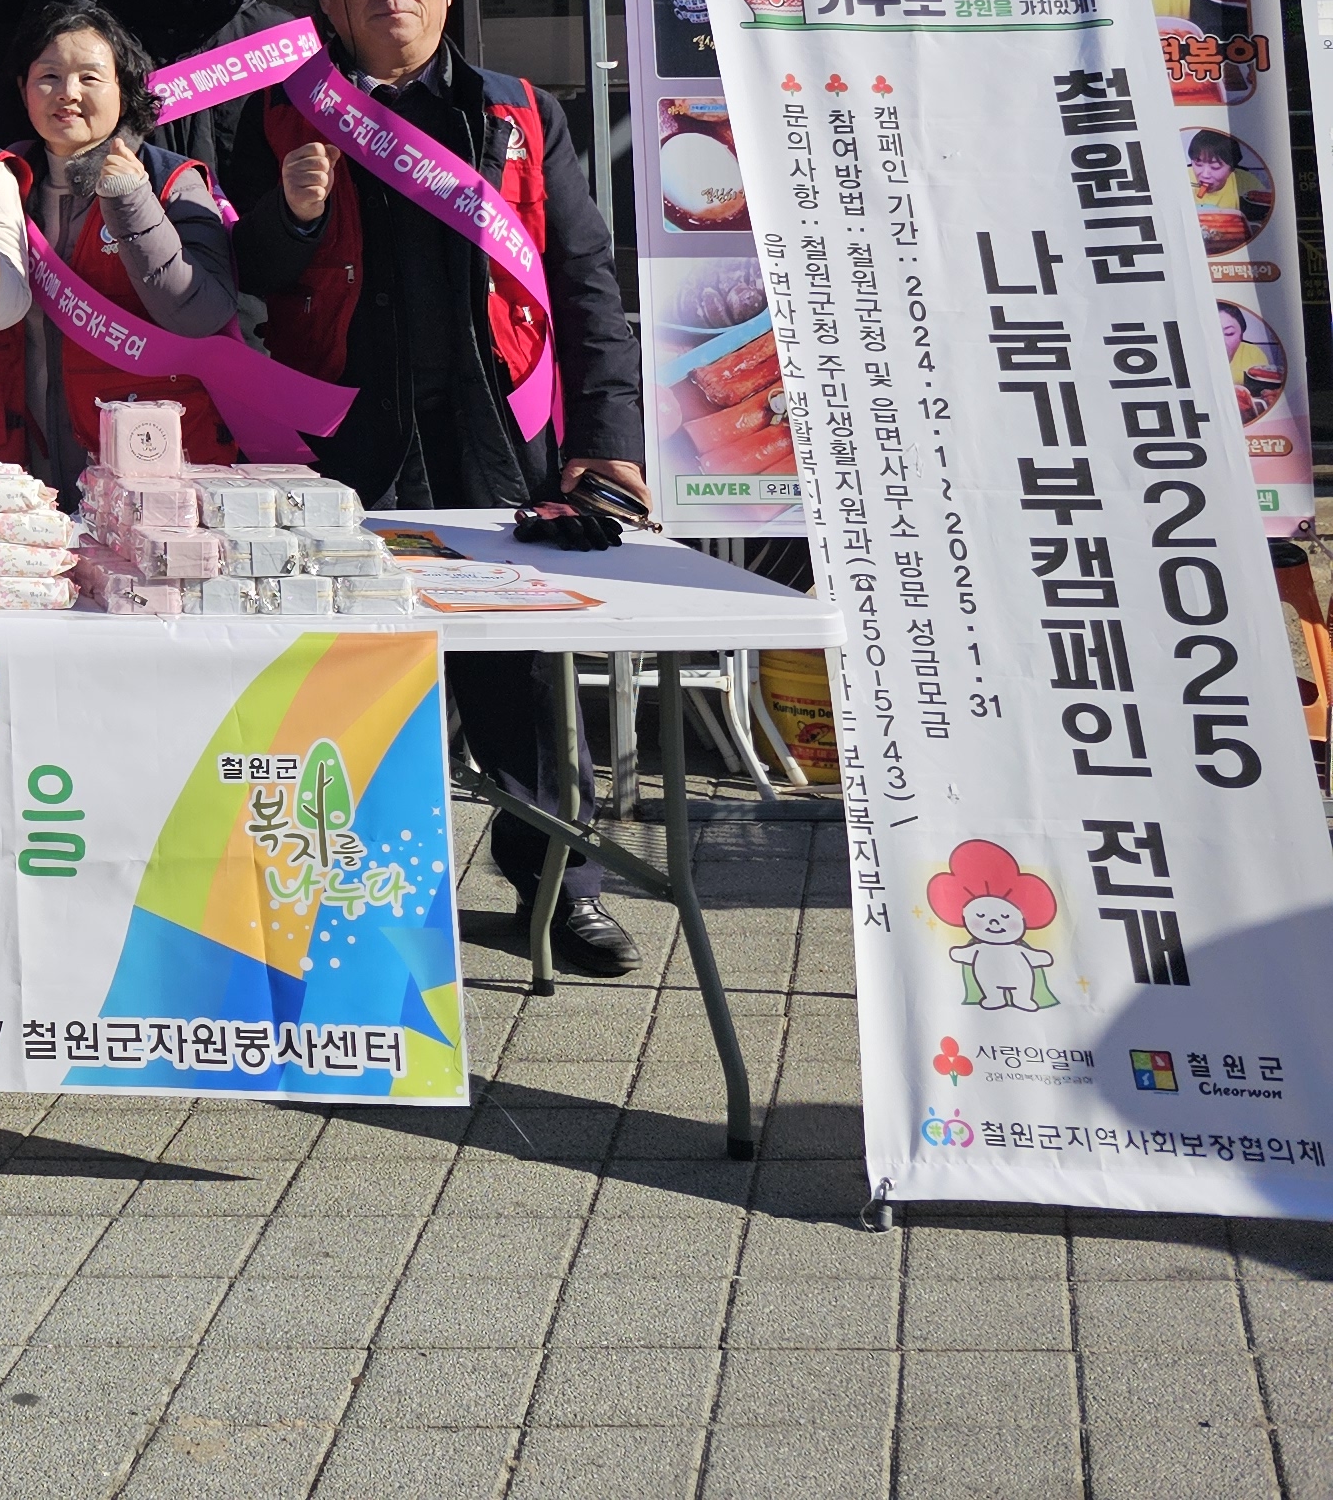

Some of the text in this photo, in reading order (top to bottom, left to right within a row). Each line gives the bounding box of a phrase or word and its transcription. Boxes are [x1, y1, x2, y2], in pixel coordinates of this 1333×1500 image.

[338, 102, 392, 157] 어려운
[392, 144, 462, 200] 이웃을
[873, 104, 910, 185] 캠페인
[1053, 68, 1166, 285] 철원군
[864, 360, 894, 389] 및
[685, 481, 752, 498] NAVER
[869, 397, 921, 540] 읍면사무소
[894, 550, 930, 610] 방문
[976, 229, 1192, 988] 나눔기부캠페인 전개
[906, 618, 951, 740] 성금모금
[220, 754, 298, 781] 철원군
[247, 789, 365, 869] 복지를
[267, 865, 410, 916] 나누다
[21, 1018, 404, 1075] 철원군자원봉사센터
[975, 1044, 1096, 1071] 사랑의열매
[1187, 1051, 1284, 1083] 철원군
[1198, 1080, 1284, 1100] Cheorwon
[980, 1120, 1326, 1168] 철원군지역사회보장협의체
